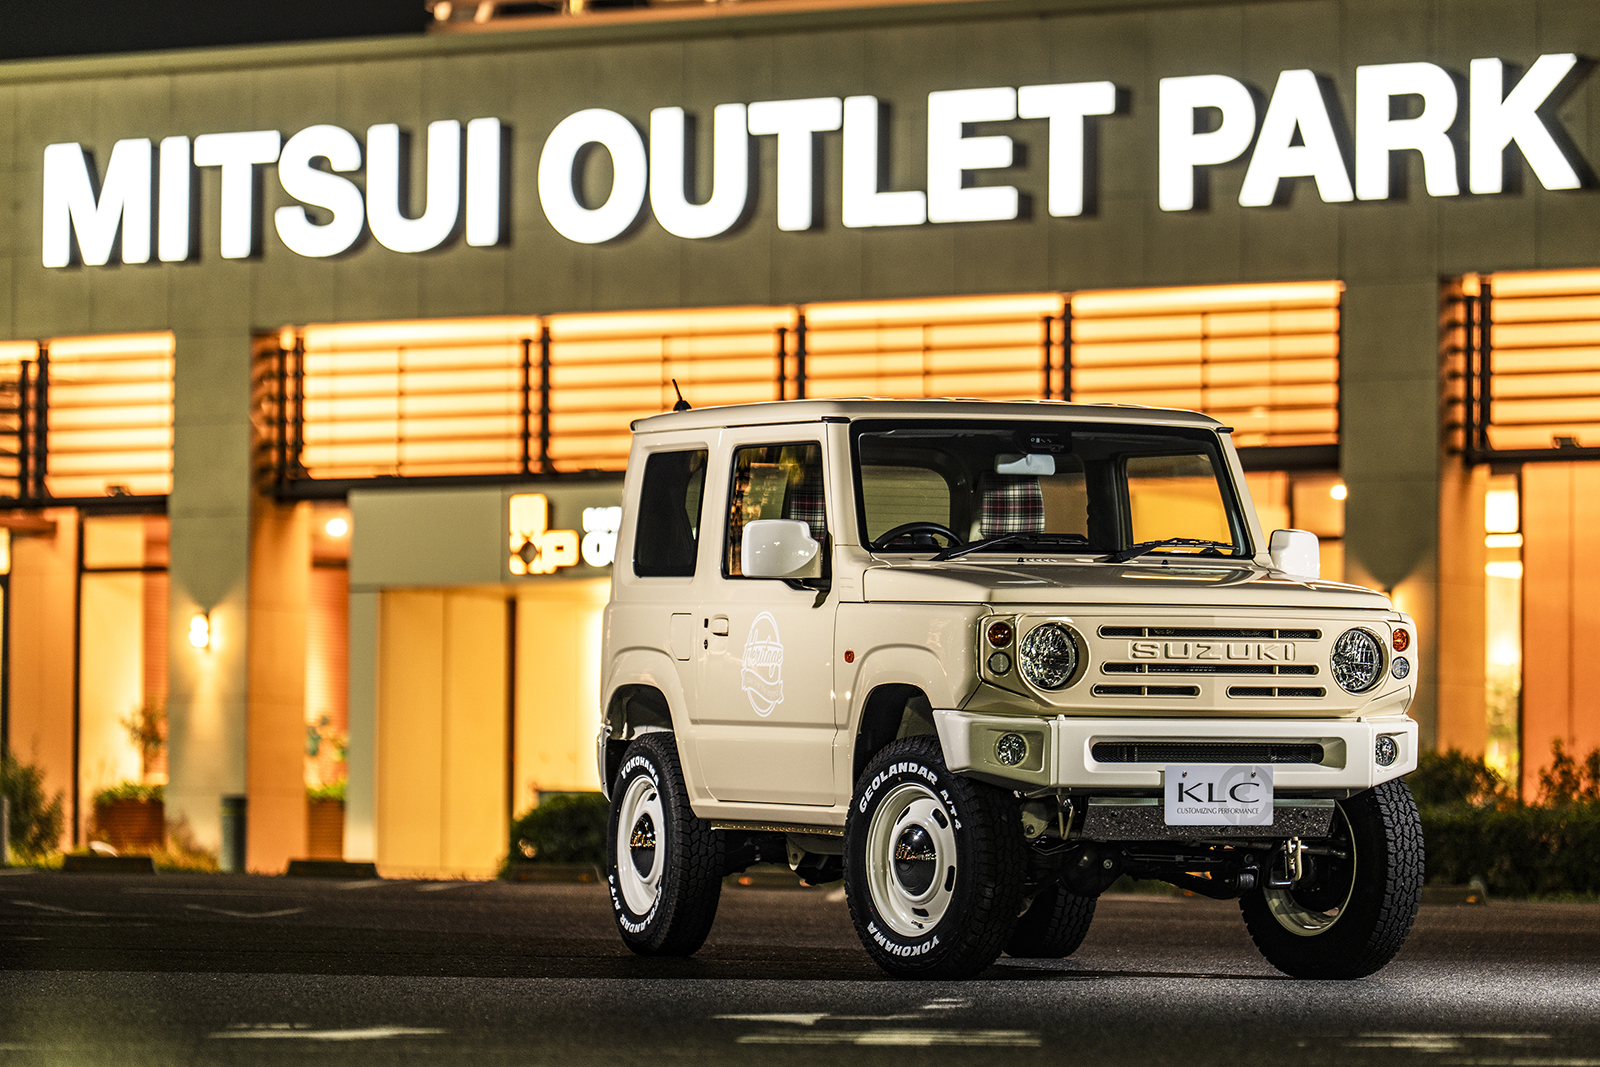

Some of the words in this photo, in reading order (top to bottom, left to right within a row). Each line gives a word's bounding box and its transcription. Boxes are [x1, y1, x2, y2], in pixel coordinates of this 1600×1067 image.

[42, 117, 500, 268] MITSUI
[537, 81, 1116, 244] OUTLET
[1158, 53, 1581, 212] PARK
[1131, 641, 1296, 661] SUZUKI
[620, 755, 659, 787] YOKOHAMA
[859, 761, 938, 813] GEOLANDAR
[1177, 782, 1260, 804] KLC
[1176, 807, 1217, 815] CUSTOMIZING
[1217, 807, 1259, 815] PERFORMANCE
[867, 920, 940, 957] YOKOHAMA
